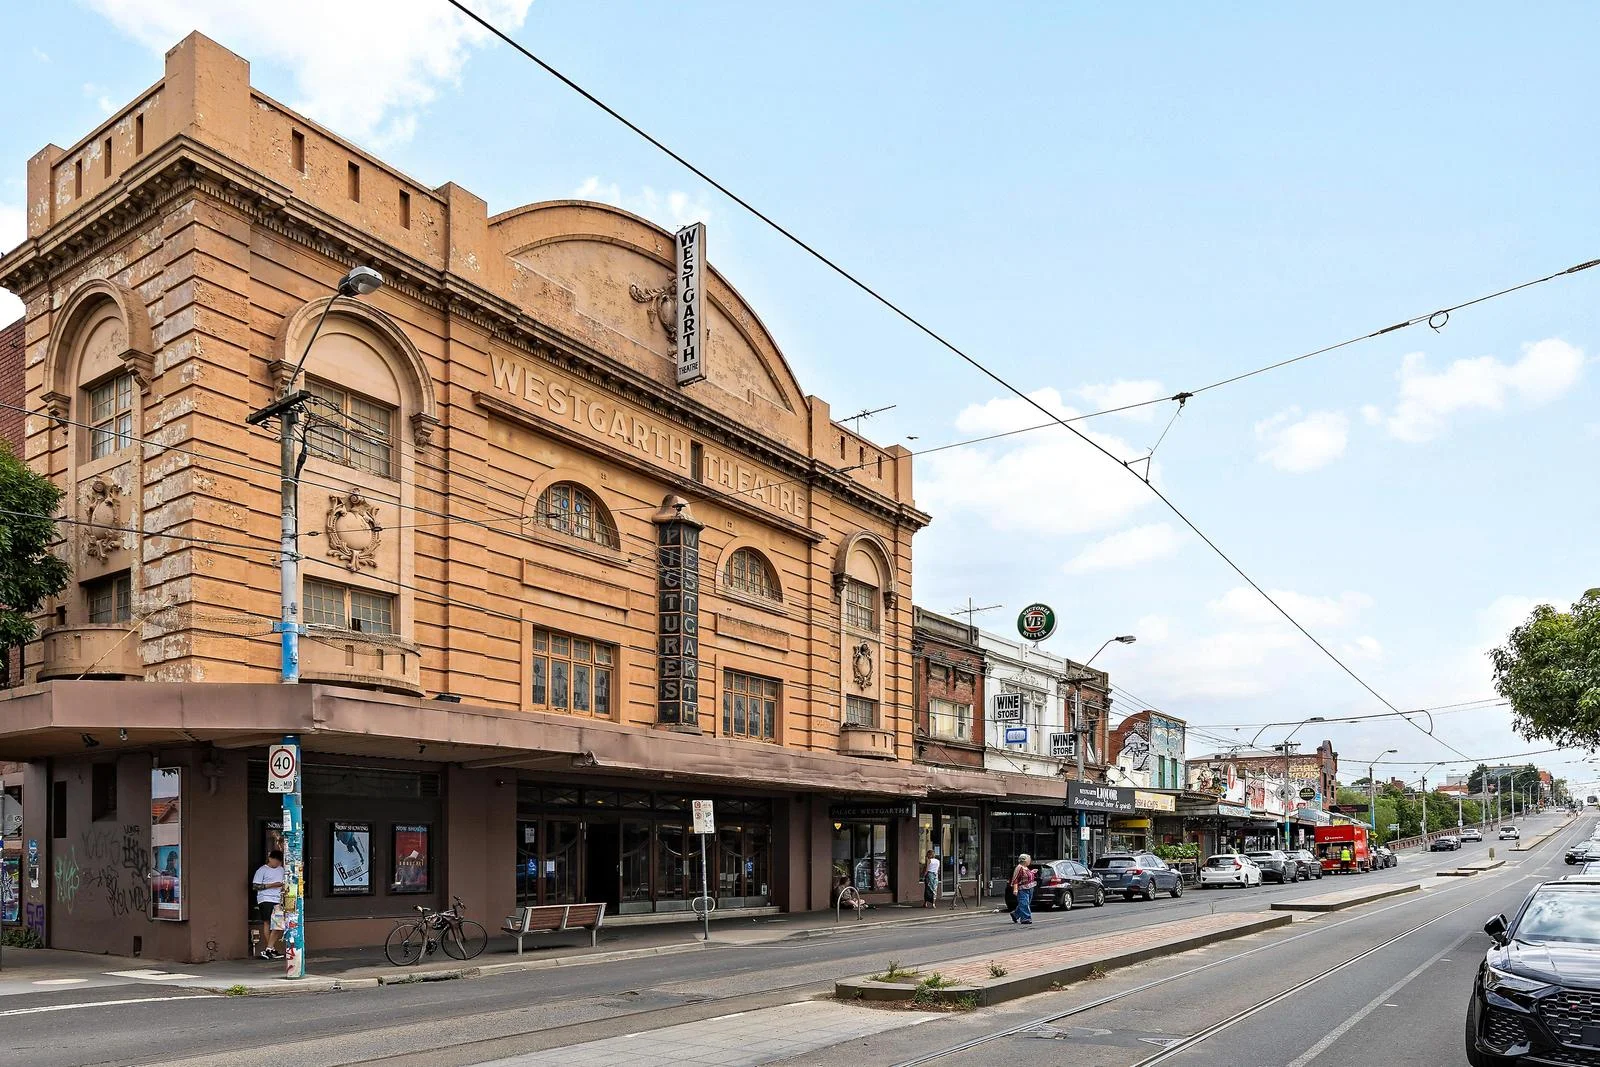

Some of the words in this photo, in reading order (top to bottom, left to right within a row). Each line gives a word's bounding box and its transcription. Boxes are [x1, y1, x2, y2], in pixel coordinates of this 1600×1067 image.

[679, 228, 697, 362] WESTGARTH
[679, 362, 698, 375] THEATRE
[488, 351, 688, 470] WESTGARTH
[704, 451, 807, 520] THEATRE
[664, 529, 680, 699] PICTURES
[1022, 606, 1051, 616] VICTORIA
[683, 529, 697, 723] WESTGARTH
[1025, 616, 1044, 627] VB
[1022, 630, 1047, 638] BITTER
[997, 696, 1019, 709] WINE
[997, 710, 1018, 719] STORE
[1052, 734, 1074, 747] WINE
[1053, 747, 1073, 755] STORE
[274, 757, 291, 770] 40
[1096, 787, 1118, 801] LIQUOR
[1074, 797, 1094, 808] Boutique
[1115, 801, 1120, 809] &
[1050, 815, 1072, 826] WINE
[1075, 814, 1105, 826] SORE
